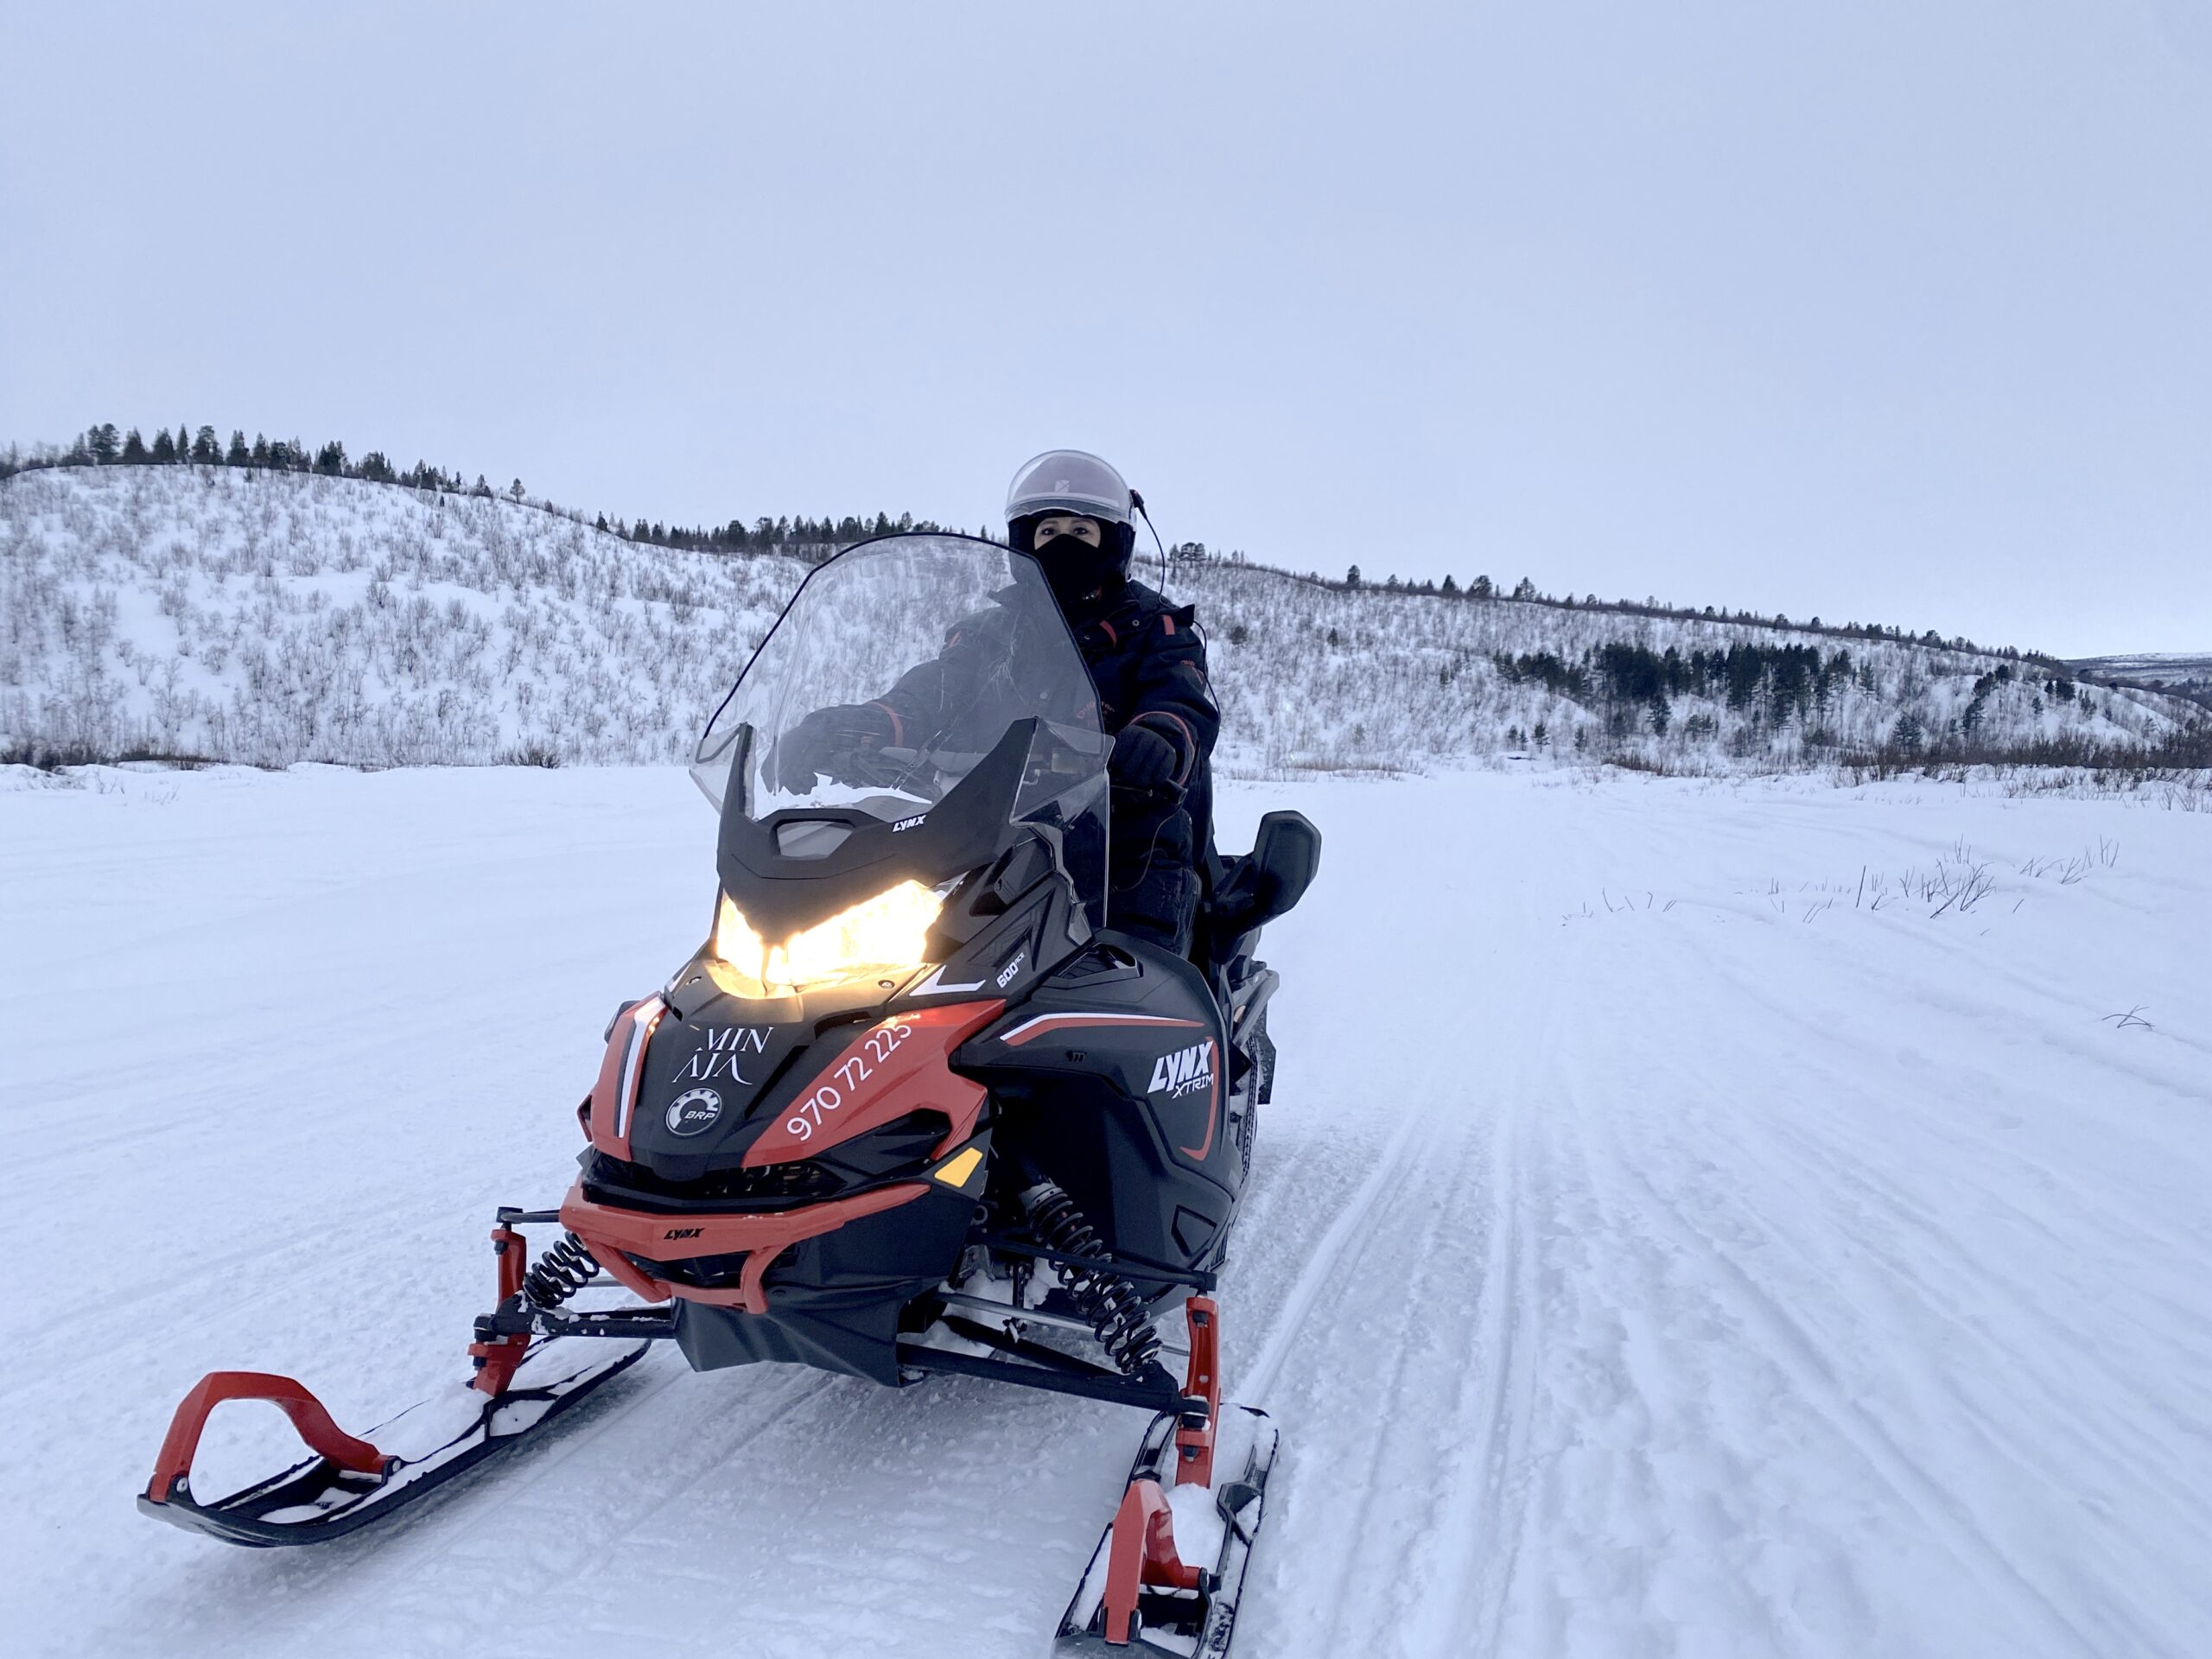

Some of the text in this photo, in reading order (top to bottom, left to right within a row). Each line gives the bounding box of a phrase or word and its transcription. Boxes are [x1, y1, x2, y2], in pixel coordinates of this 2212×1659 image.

[892, 814, 927, 832] LYNX
[996, 961, 1019, 988] 600
[695, 1027, 774, 1053] MIN
[1147, 1040, 1214, 1094] LYNX
[786, 1025, 912, 1141] 970 72 225
[1172, 1073, 1214, 1099] XTRIM
[684, 1110, 715, 1121] BRP
[663, 1227, 706, 1241] LYNX
